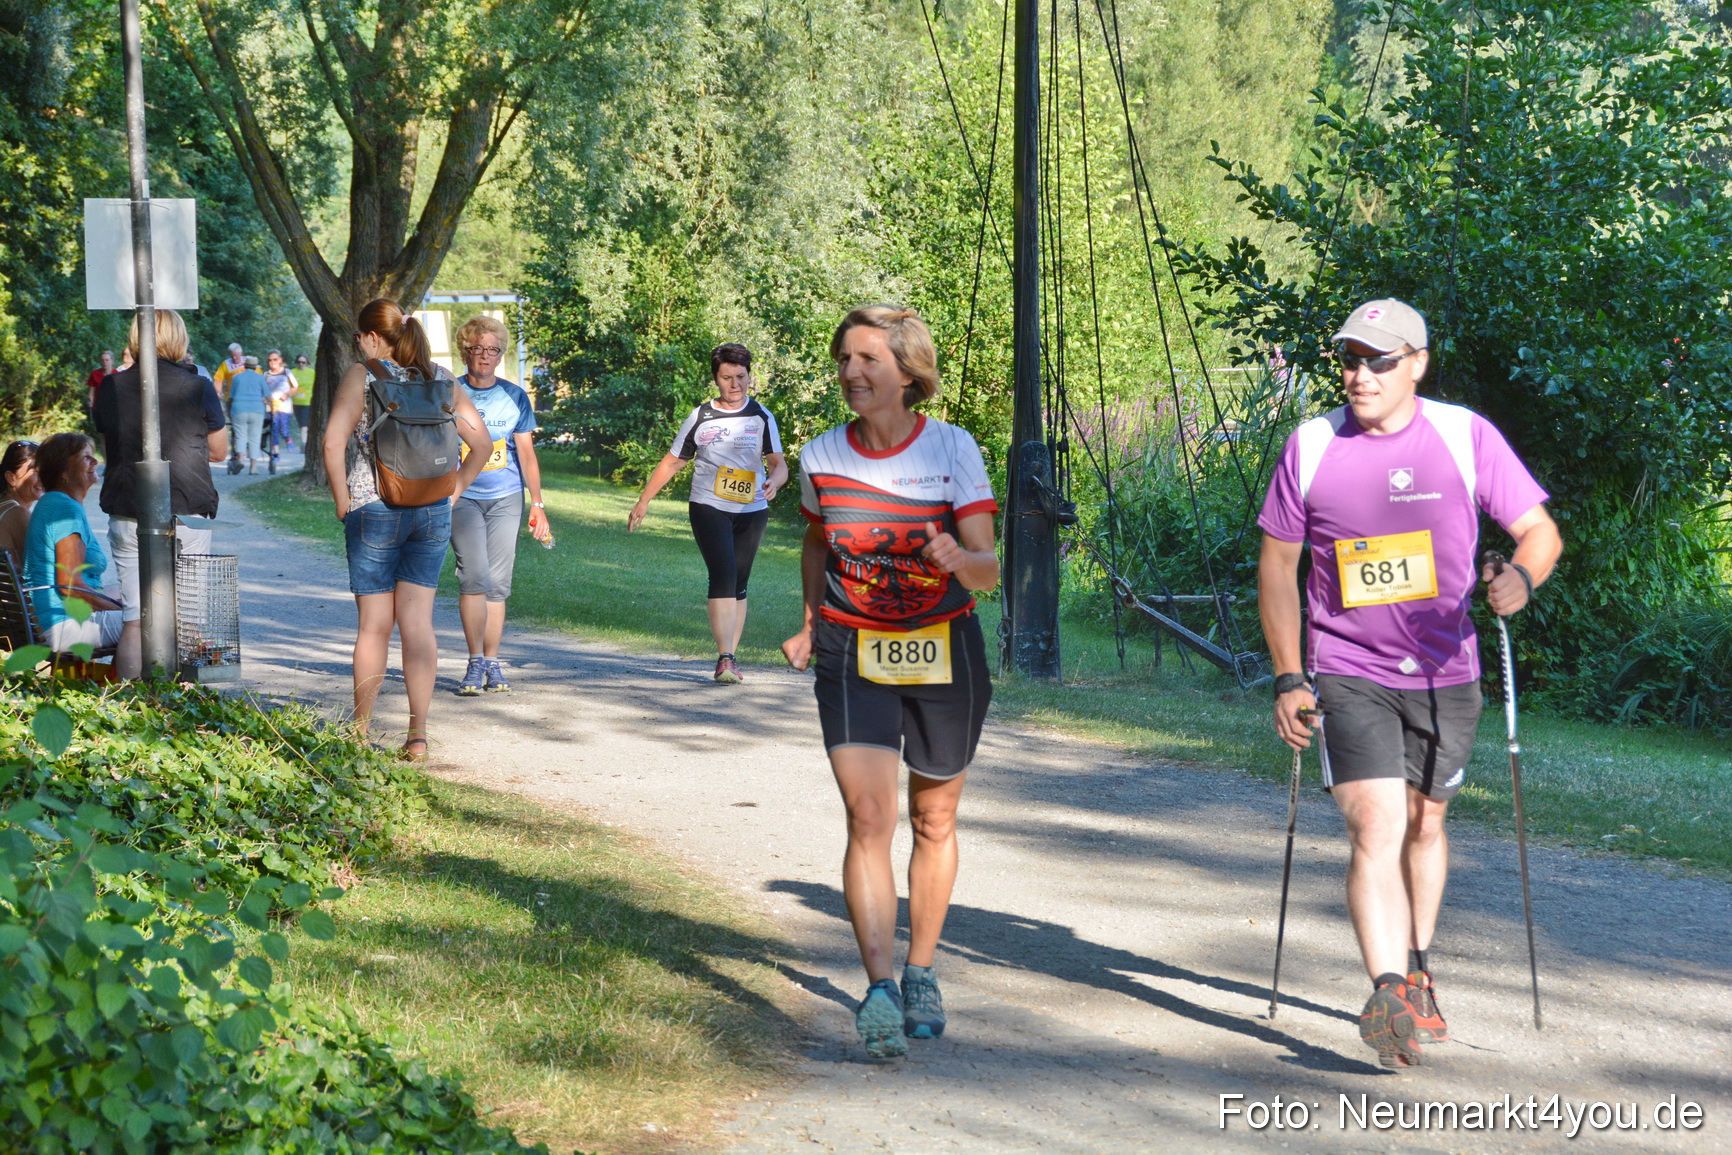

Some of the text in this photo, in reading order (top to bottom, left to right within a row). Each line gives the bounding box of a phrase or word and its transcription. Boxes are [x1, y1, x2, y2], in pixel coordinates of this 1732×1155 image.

[482, 419, 507, 428] ÜLLER
[721, 478, 752, 494] 1468
[891, 475, 942, 486] NEUMARKT
[1360, 558, 1410, 586] 681
[871, 640, 937, 664] 1880
